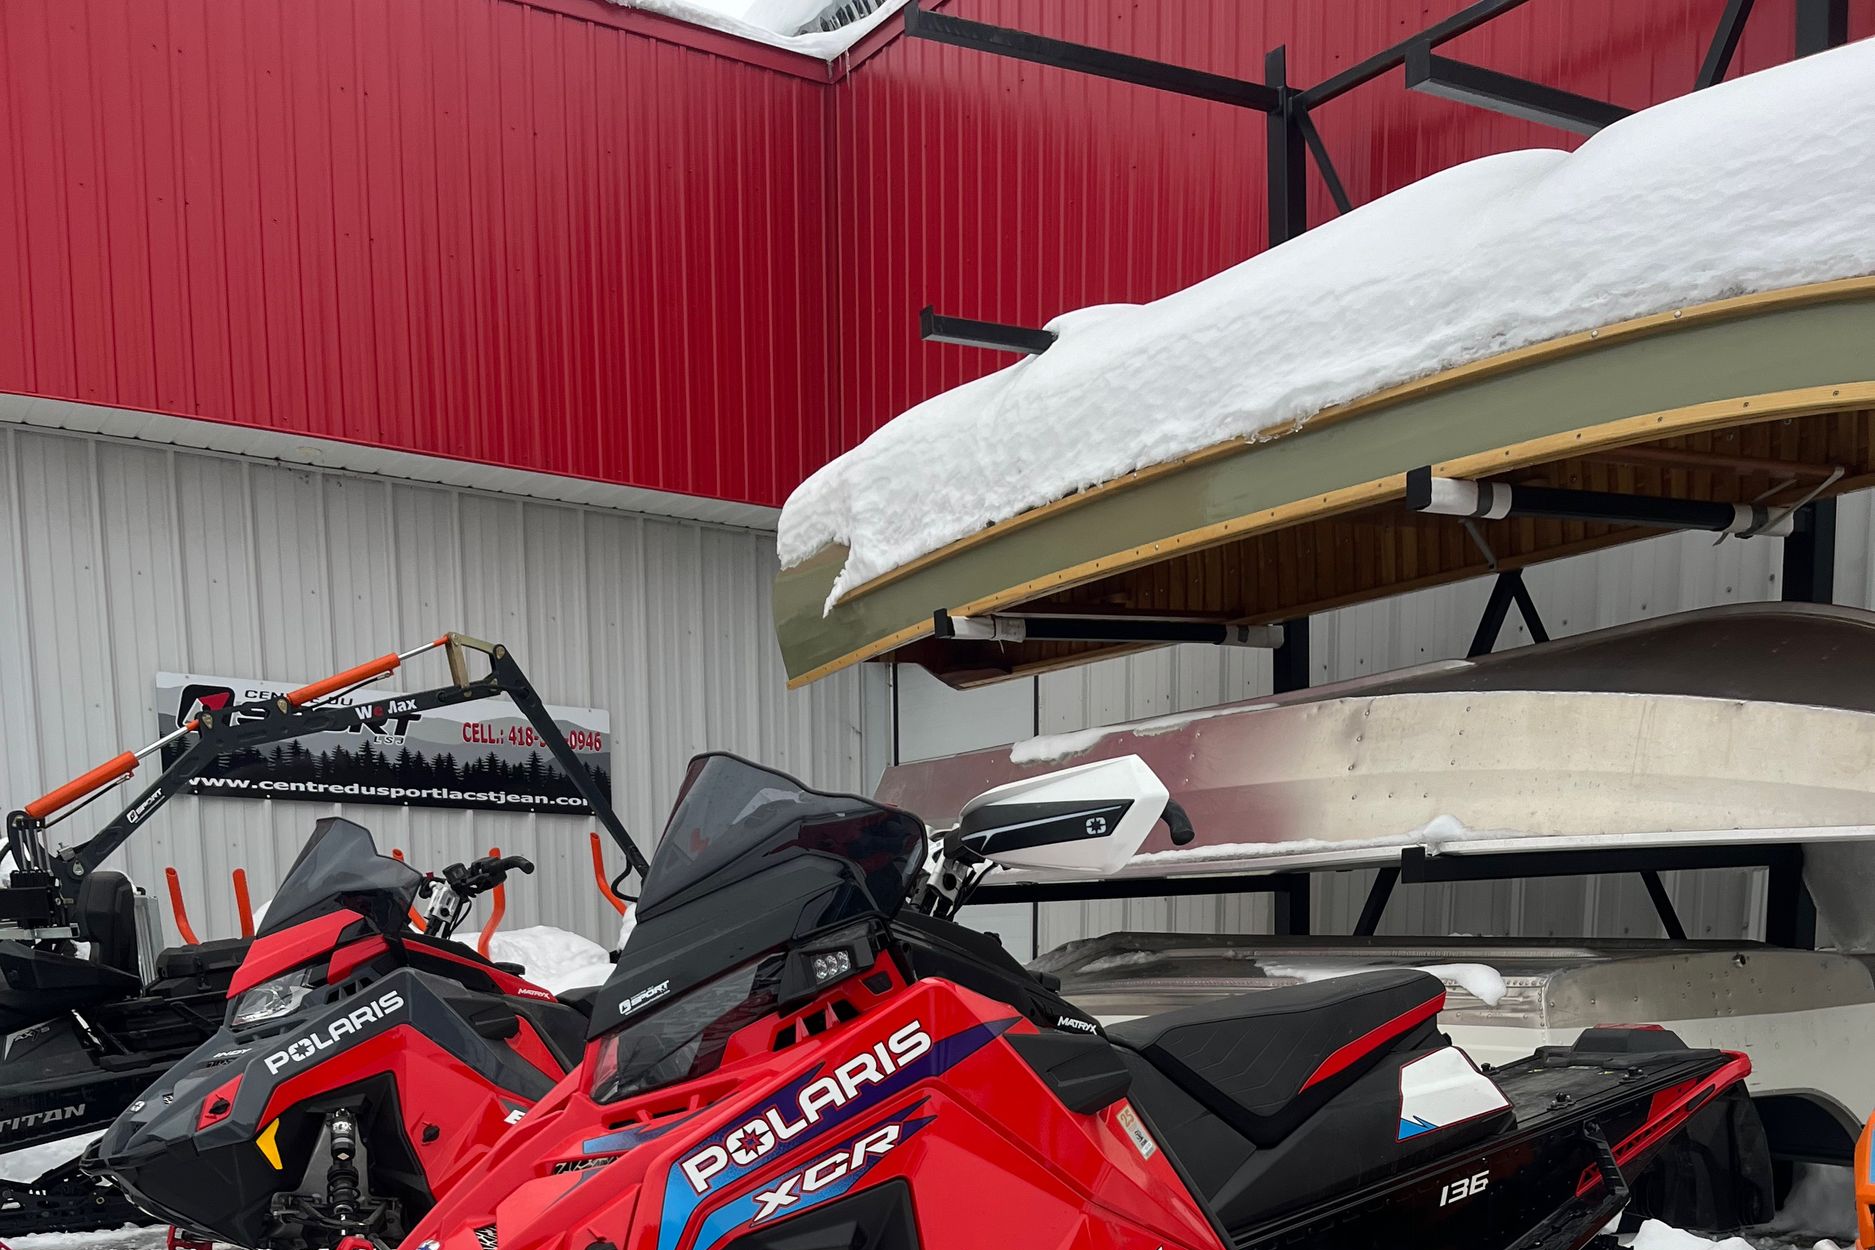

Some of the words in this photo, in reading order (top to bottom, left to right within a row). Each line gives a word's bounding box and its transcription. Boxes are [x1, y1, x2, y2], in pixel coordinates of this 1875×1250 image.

[508, 725, 602, 752] 418--0946
[630, 979, 670, 1007] SPORT
[263, 989, 405, 1076] POLARIS
[1057, 1015, 1098, 1036] MATRYX
[681, 1019, 933, 1195] POLARIS
[752, 1123, 901, 1223] XCR
[1440, 1169, 1490, 1207] 136
